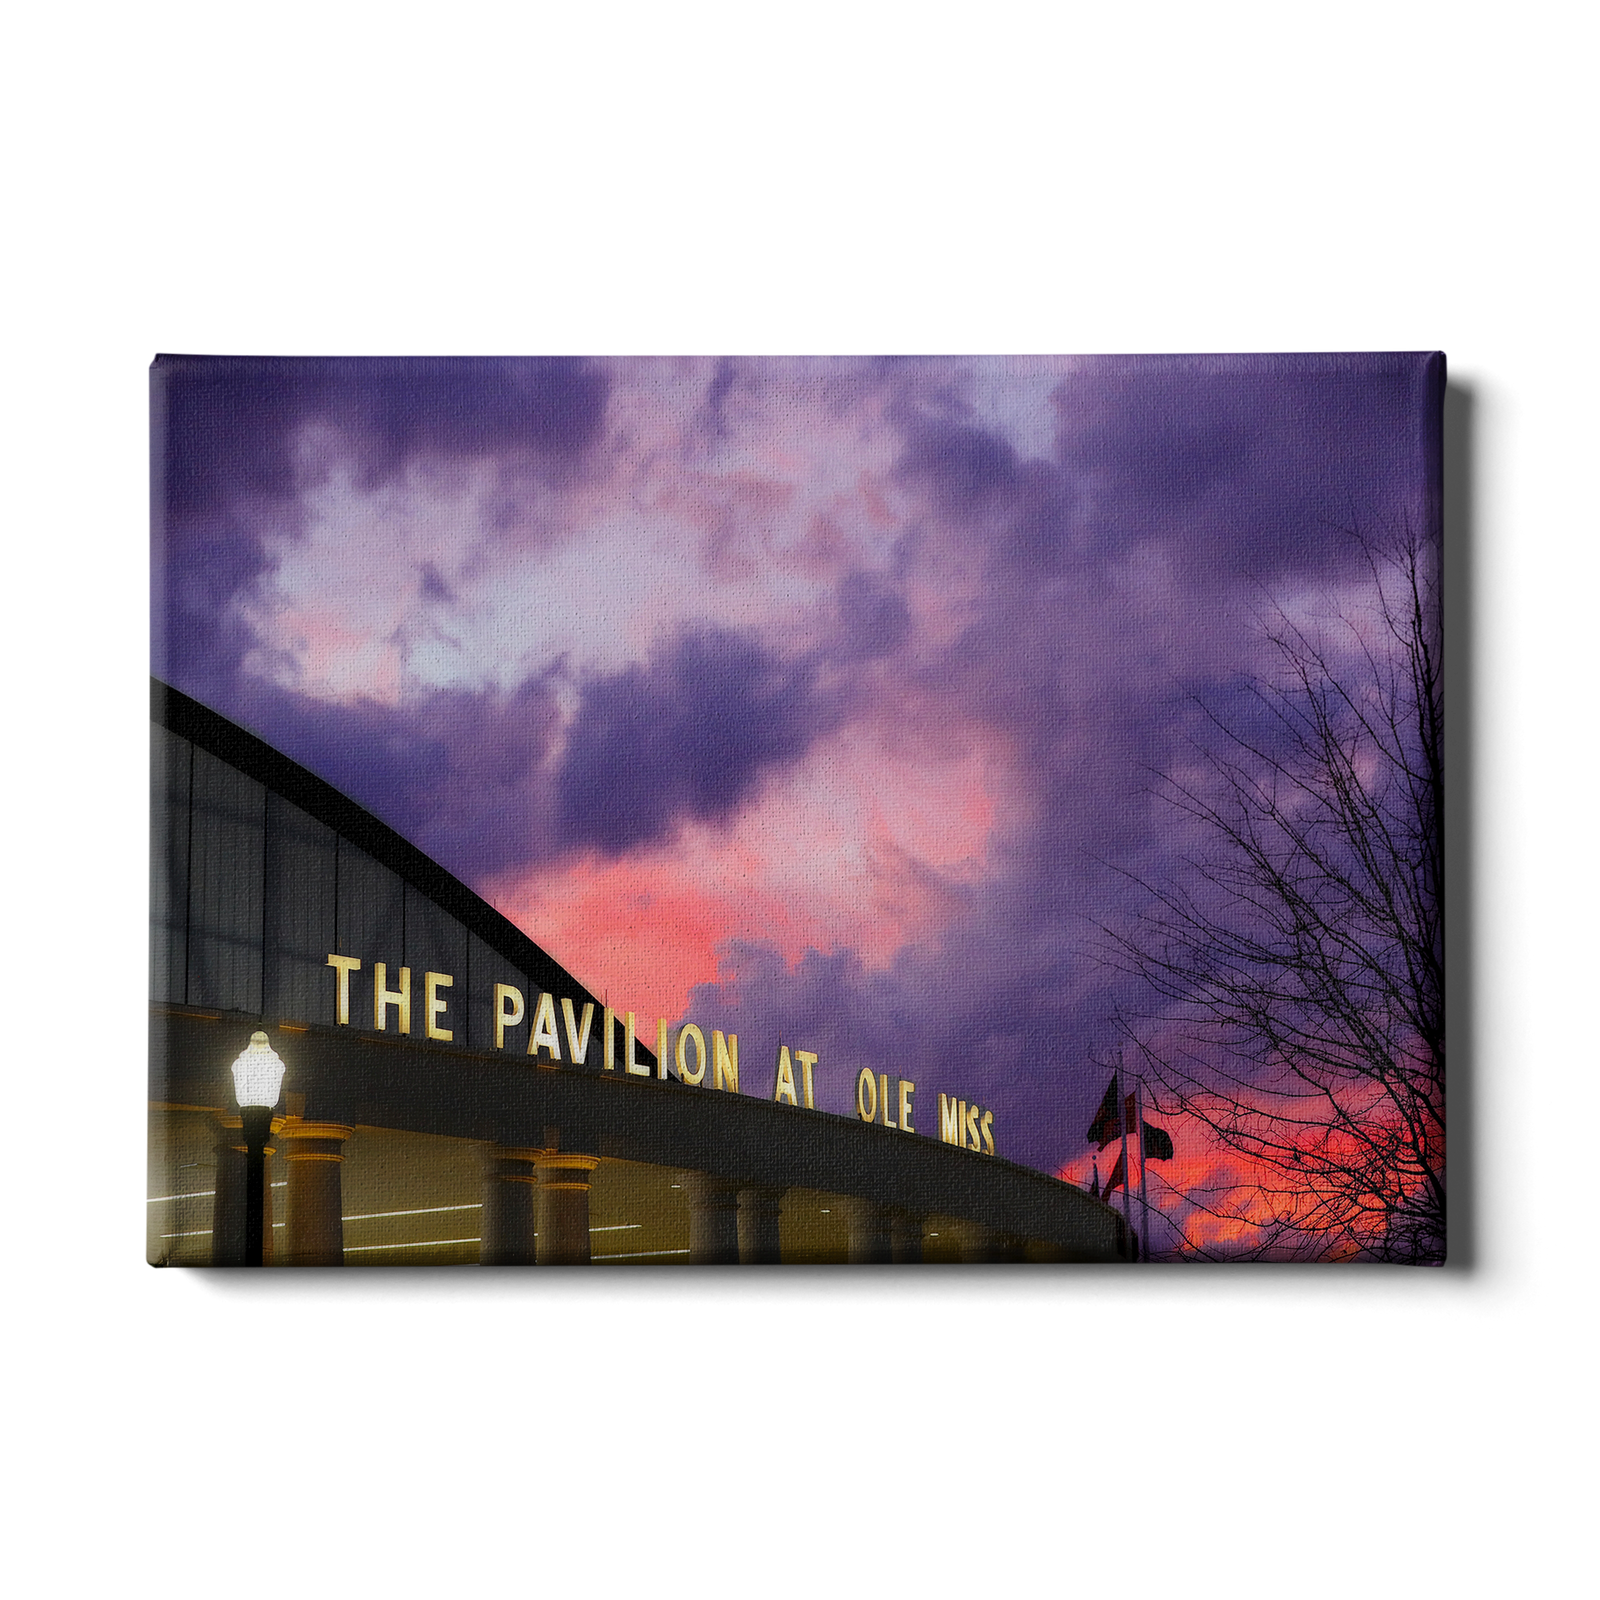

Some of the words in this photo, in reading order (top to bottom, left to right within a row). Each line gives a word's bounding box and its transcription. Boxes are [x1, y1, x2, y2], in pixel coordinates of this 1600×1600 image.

[326, 953, 453, 1041] THE
[493, 983, 738, 1093] PAVILION
[775, 1045, 818, 1109] AT
[856, 1067, 915, 1133] OLE
[938, 1093, 995, 1156] MISS
